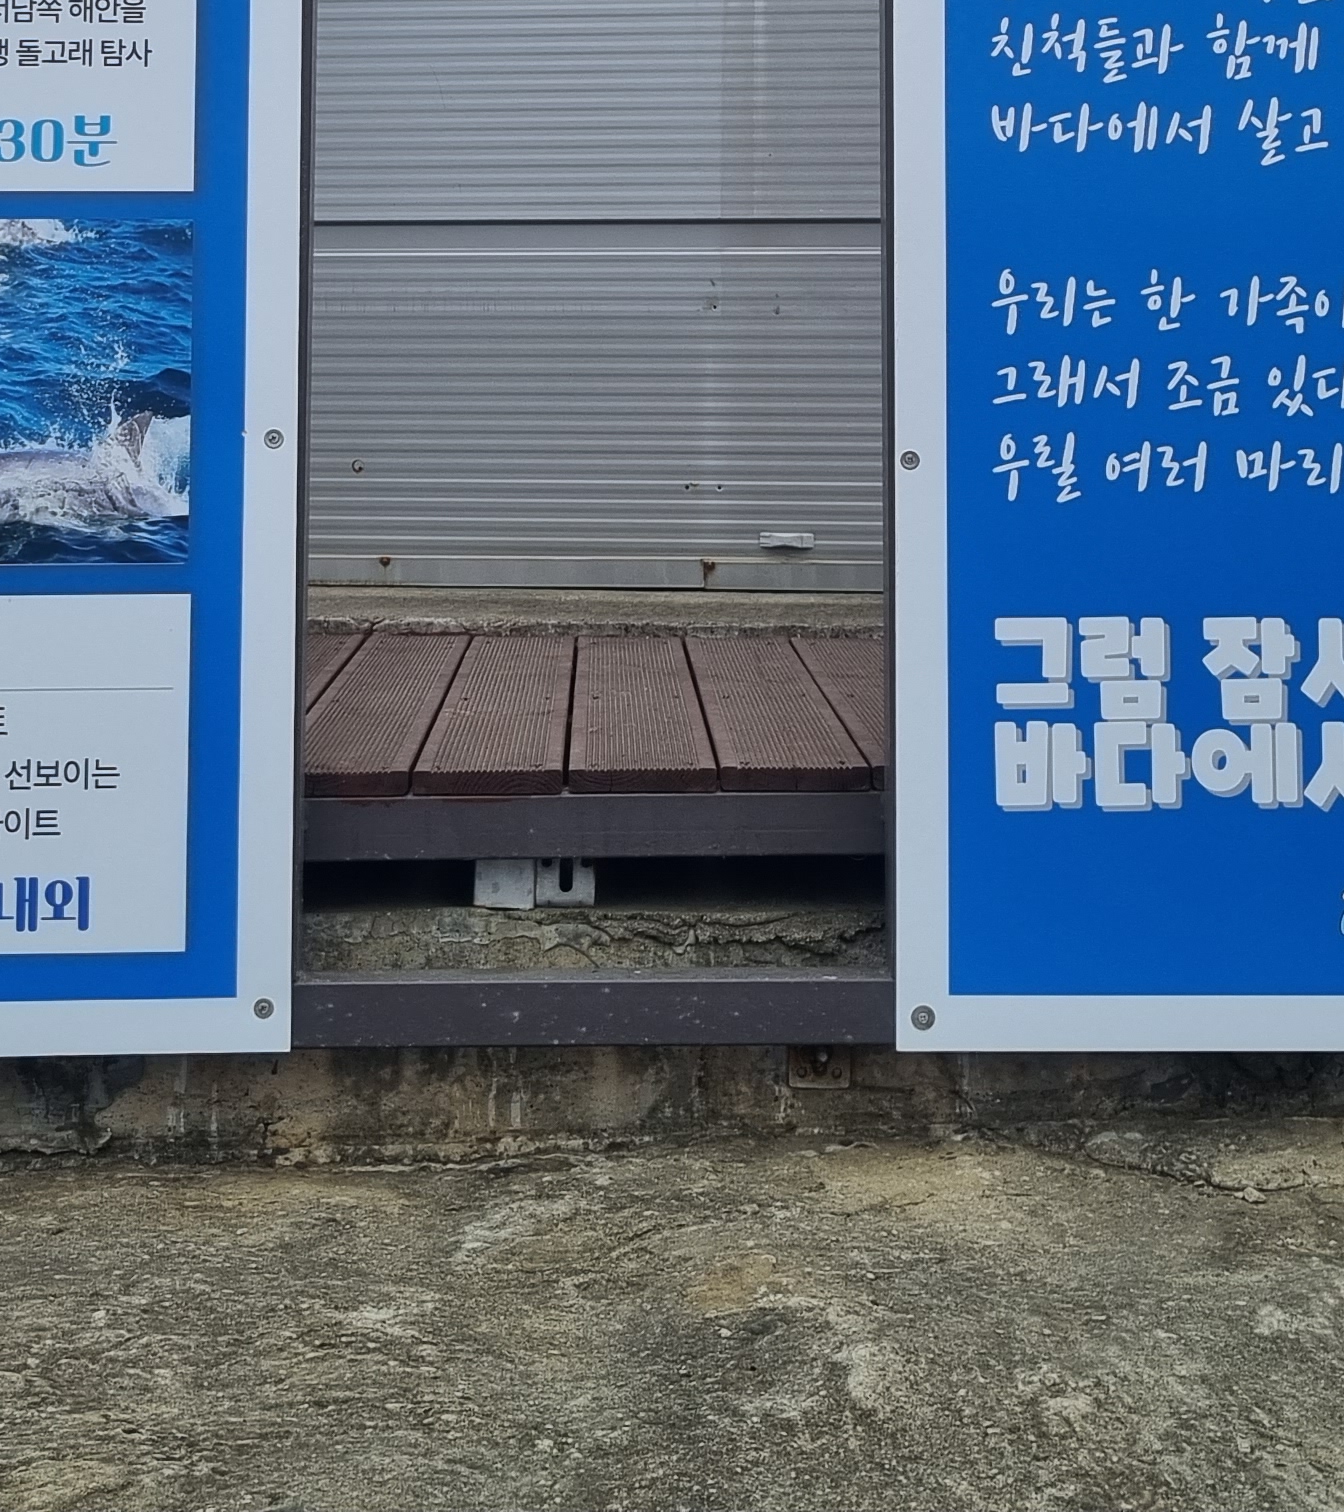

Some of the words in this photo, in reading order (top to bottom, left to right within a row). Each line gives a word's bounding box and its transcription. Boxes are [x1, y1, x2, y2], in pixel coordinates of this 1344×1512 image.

[15, 38, 93, 68] 돌고래
[100, 39, 153, 69] 탐사
[991, 13, 1184, 84] 친척들과
[1207, 13, 1318, 80] 함께
[992, 101, 1212, 153] 바다에서
[1237, 97, 1329, 166] 살고
[991, 268, 1116, 335] 우리는
[1140, 268, 1196, 332] 한
[992, 354, 1140, 409] 그래서
[1167, 355, 1240, 417] 조금
[992, 431, 1082, 504] 우릴
[1105, 440, 1208, 493] 여러
[994, 615, 1171, 725] 그럼
[4, 758, 120, 790] 선보이는
